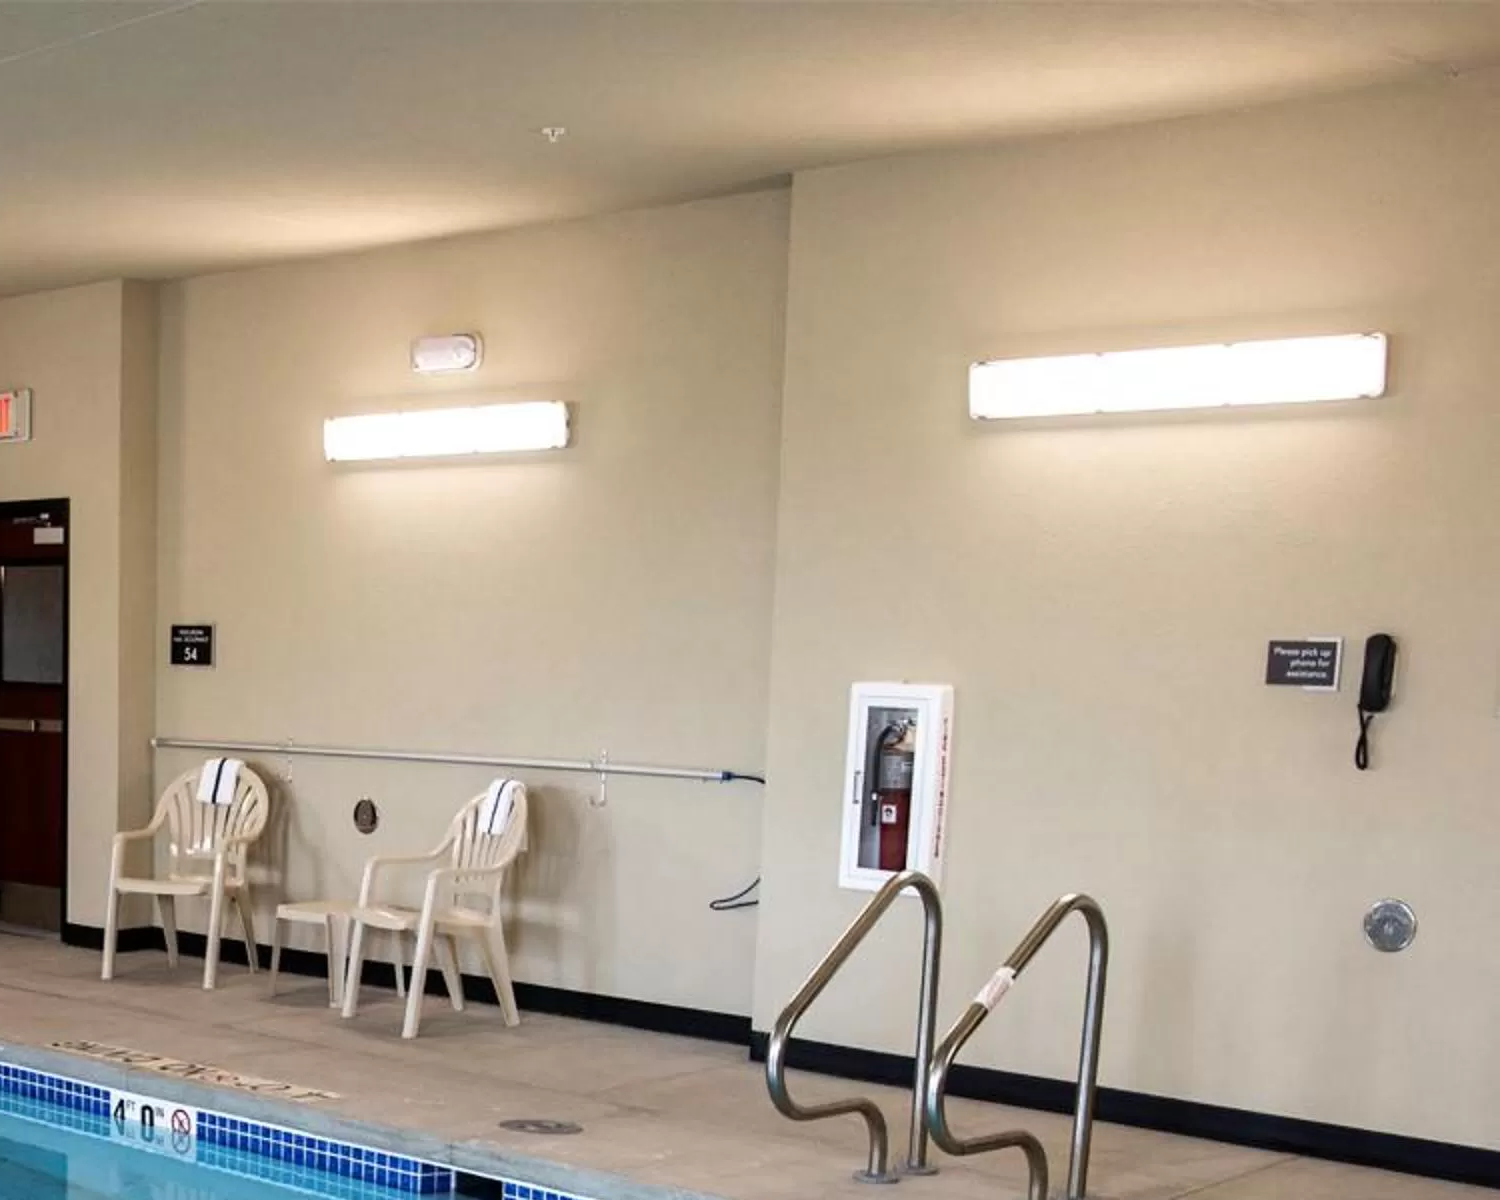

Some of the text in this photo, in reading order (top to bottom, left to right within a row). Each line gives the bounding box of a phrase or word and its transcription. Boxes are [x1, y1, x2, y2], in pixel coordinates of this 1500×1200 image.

[183, 647, 198, 661] 54
[1274, 647, 1300, 657] Please
[1301, 648, 1318, 658] pick
[114, 1099, 125, 1120] 4
